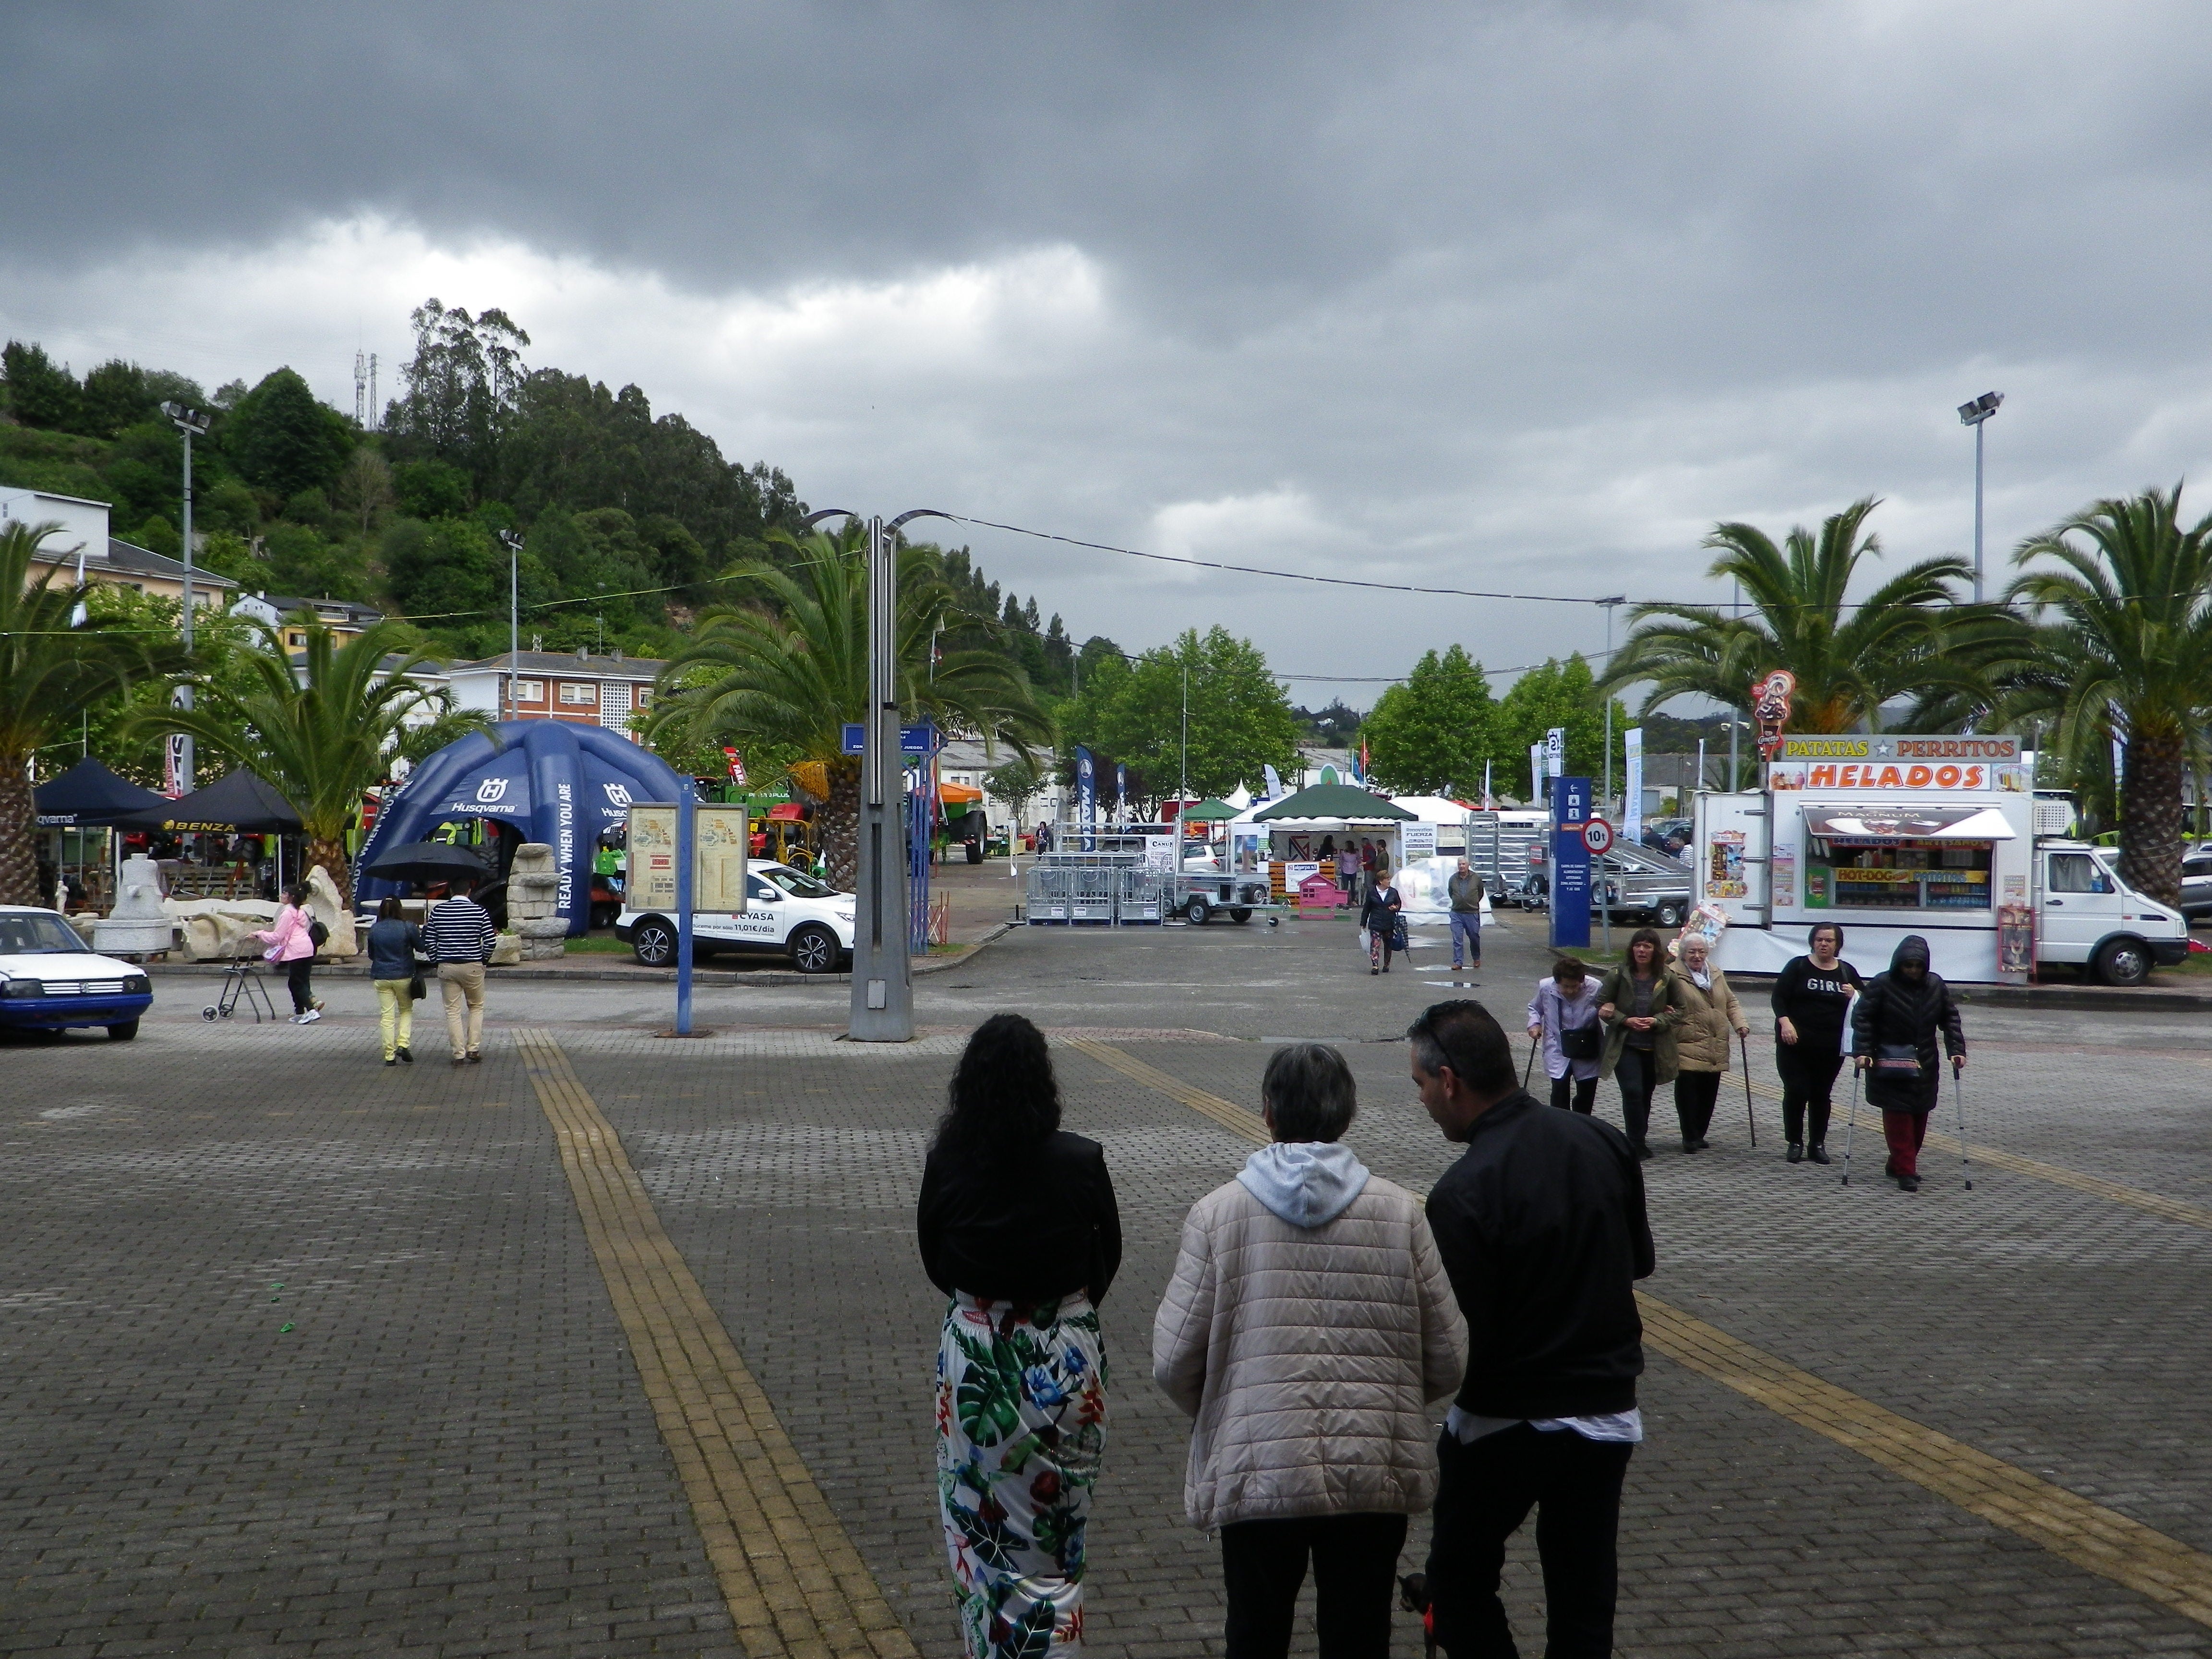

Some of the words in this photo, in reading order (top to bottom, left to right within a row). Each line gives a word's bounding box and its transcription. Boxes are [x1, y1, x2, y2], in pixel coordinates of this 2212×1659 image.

[1786, 740, 1869, 757] PATATAS
[1897, 740, 2014, 757] PERRITOS
[1809, 765, 1984, 789] HELADOS
[558, 783, 571, 802] ARE
[451, 803, 516, 814] Husqvarna
[560, 802, 572, 828] YOU
[37, 815, 74, 825] qvarna
[176, 822, 235, 832] BENZA
[359, 824, 382, 857] WHEN
[379, 799, 395, 820] YOU
[560, 829, 573, 866] WHEN
[1838, 869, 1893, 881] HOT-DOG
[1912, 871, 1966, 882] PATATAS
[558, 867, 573, 909] READY
[740, 913, 774, 921] CYASA
[1807, 978, 1846, 993] GIRL
